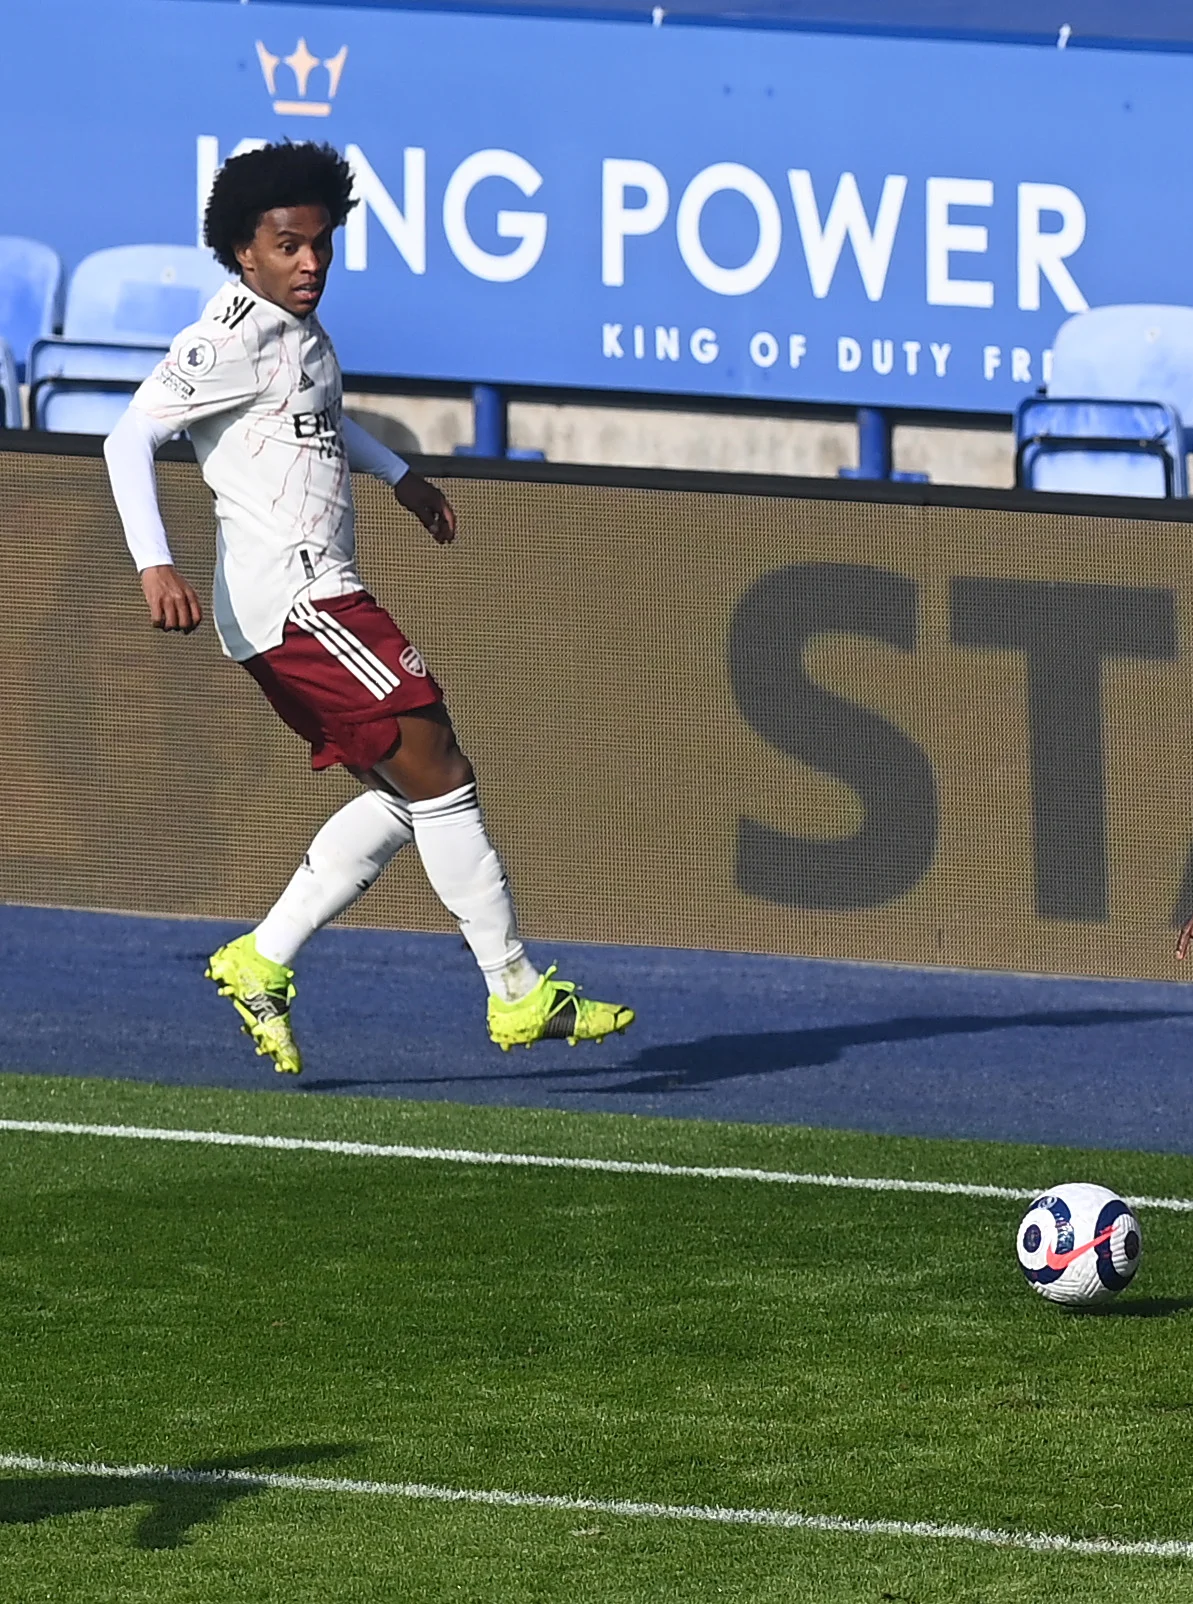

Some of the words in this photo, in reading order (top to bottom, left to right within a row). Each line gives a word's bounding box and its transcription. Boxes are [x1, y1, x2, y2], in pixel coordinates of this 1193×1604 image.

[197, 134, 548, 282] NG
[602, 158, 1090, 312] POWER
[602, 324, 720, 364] KING
[750, 331, 807, 368] OF
[837, 337, 951, 377] DUTY
